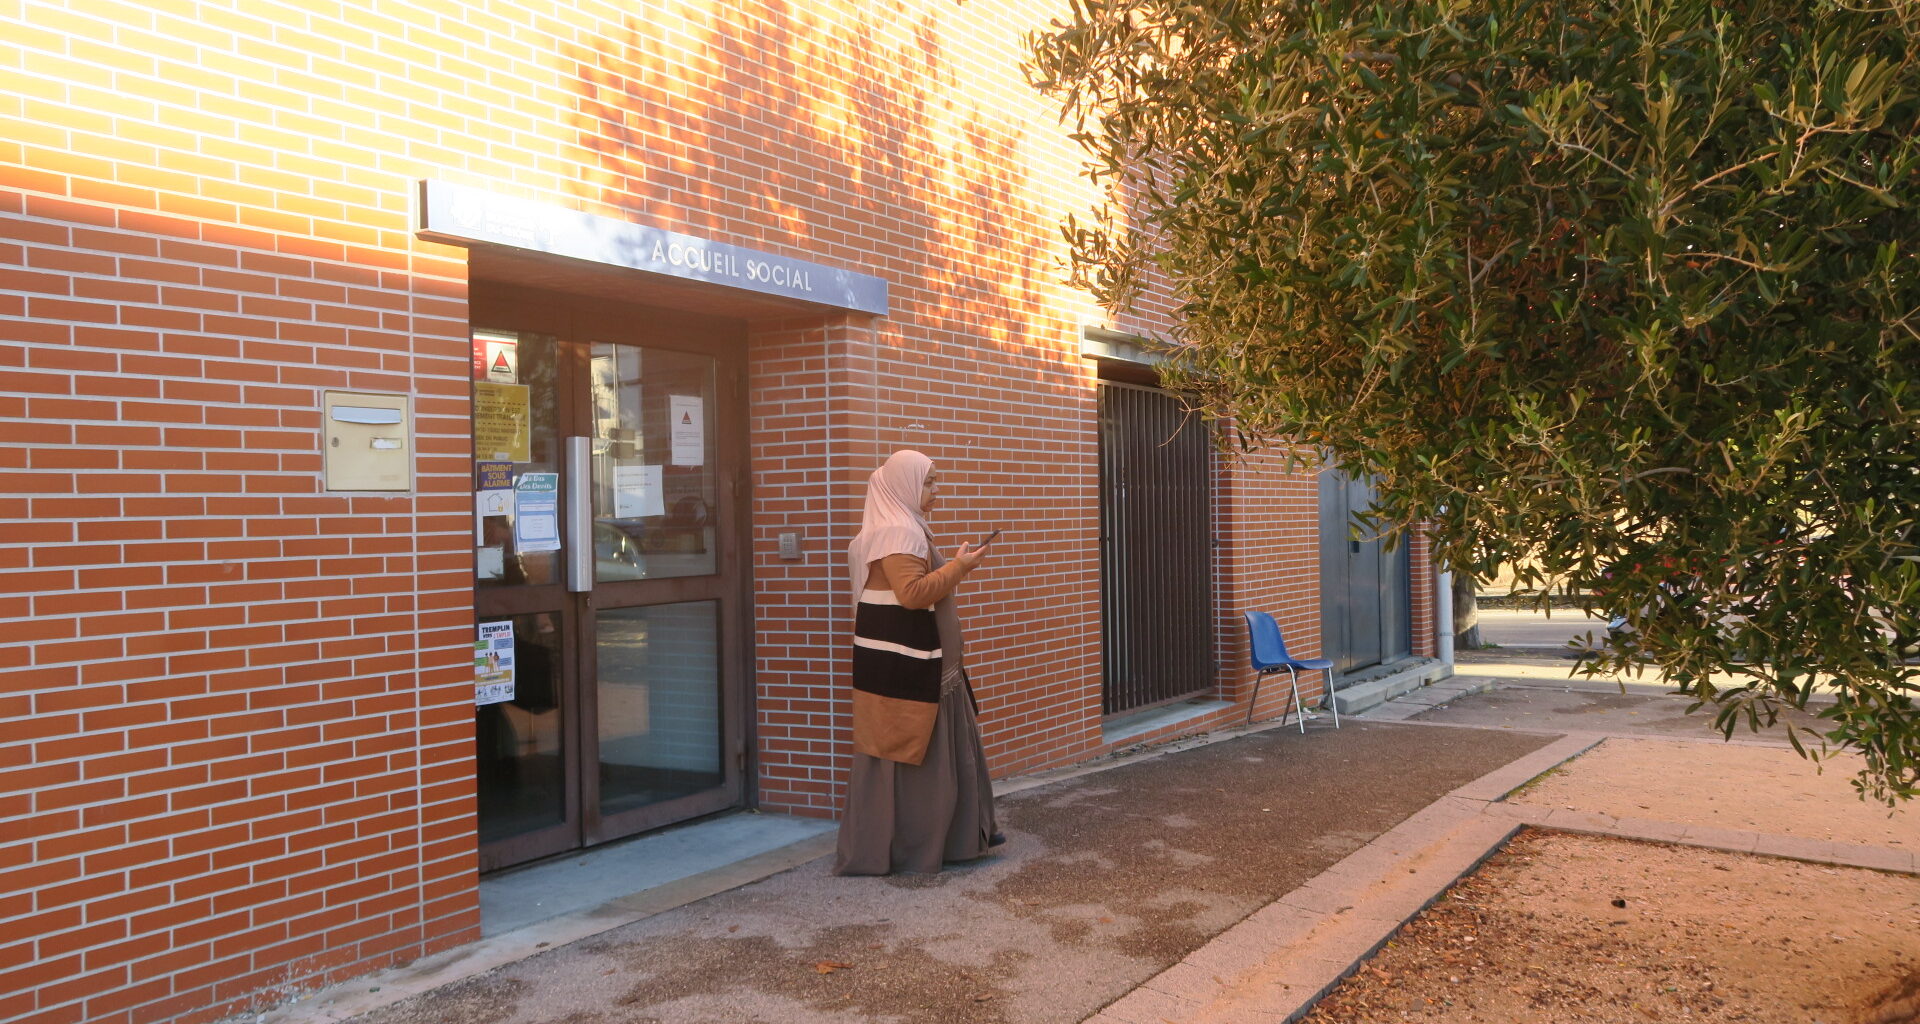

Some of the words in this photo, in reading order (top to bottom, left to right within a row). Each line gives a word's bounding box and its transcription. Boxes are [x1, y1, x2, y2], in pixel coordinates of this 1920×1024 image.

[652, 239, 739, 278] ACCUEIL
[746, 259, 812, 291] SOCIAL
[481, 464, 512, 472] BÂTIMENT
[482, 625, 510, 633] TREMPLIN
